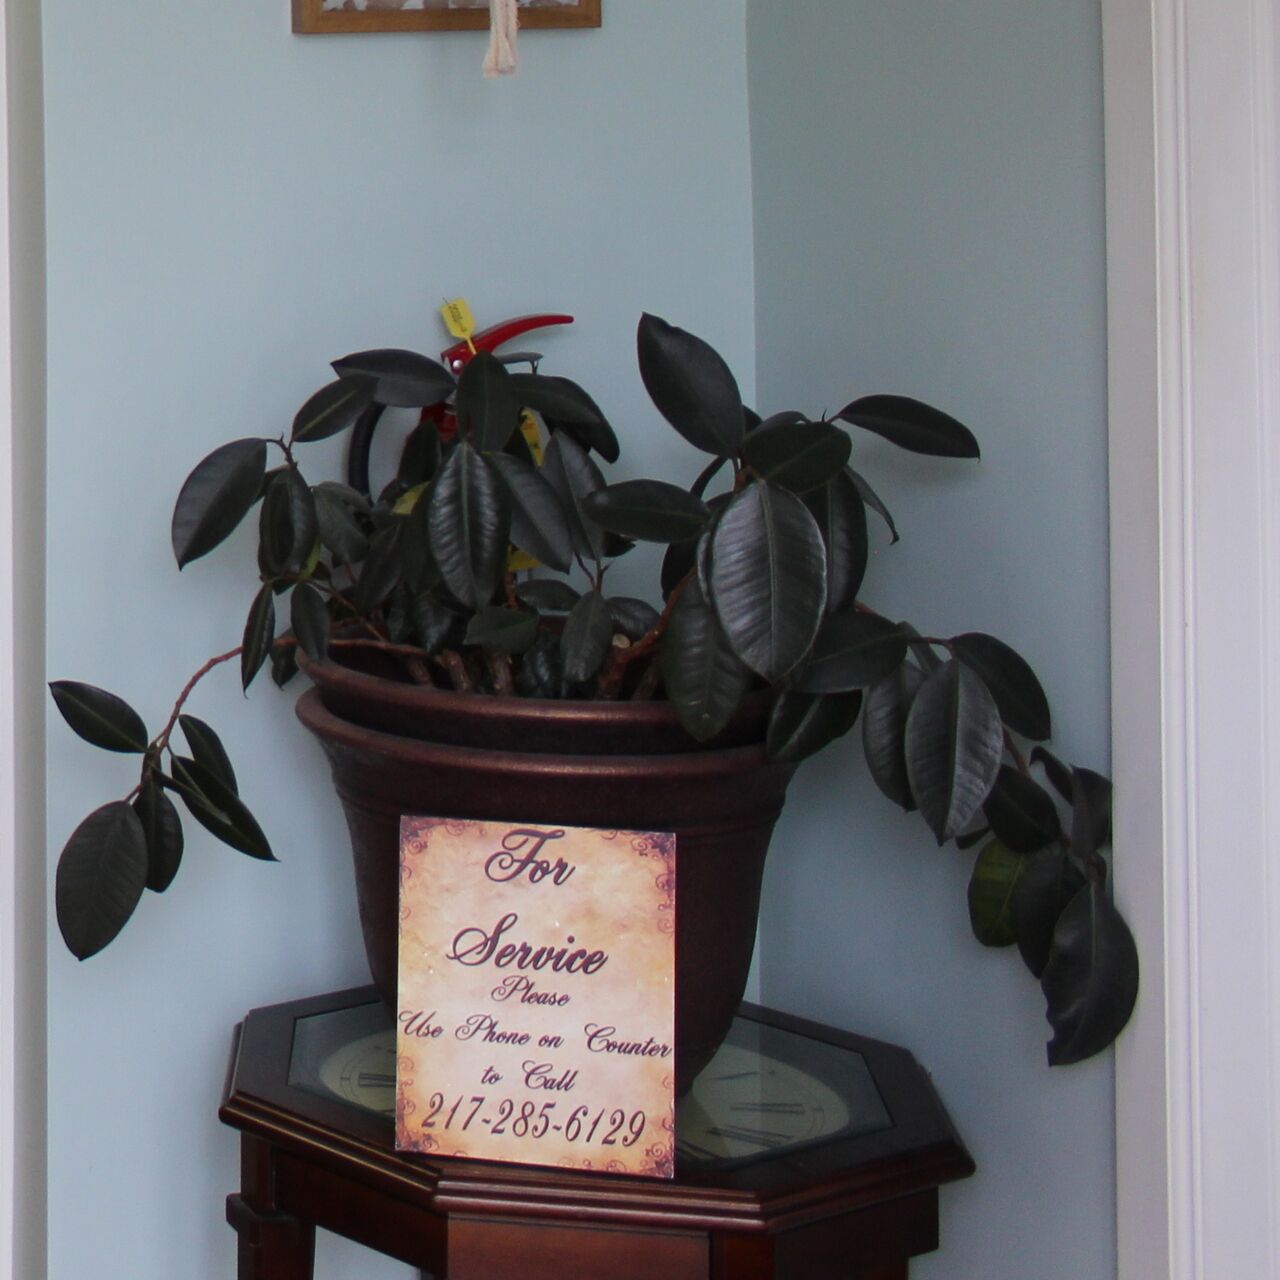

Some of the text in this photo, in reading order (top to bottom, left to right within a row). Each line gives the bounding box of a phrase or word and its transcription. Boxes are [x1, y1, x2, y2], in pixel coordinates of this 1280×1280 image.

[484, 828, 575, 887] For
[446, 912, 608, 975] Service
[490, 974, 570, 1007] Please
[398, 1010, 673, 1059] Use Phone on Counter
[480, 1060, 578, 1091] to Call
[421, 1092, 646, 1148] 217-285-6129
